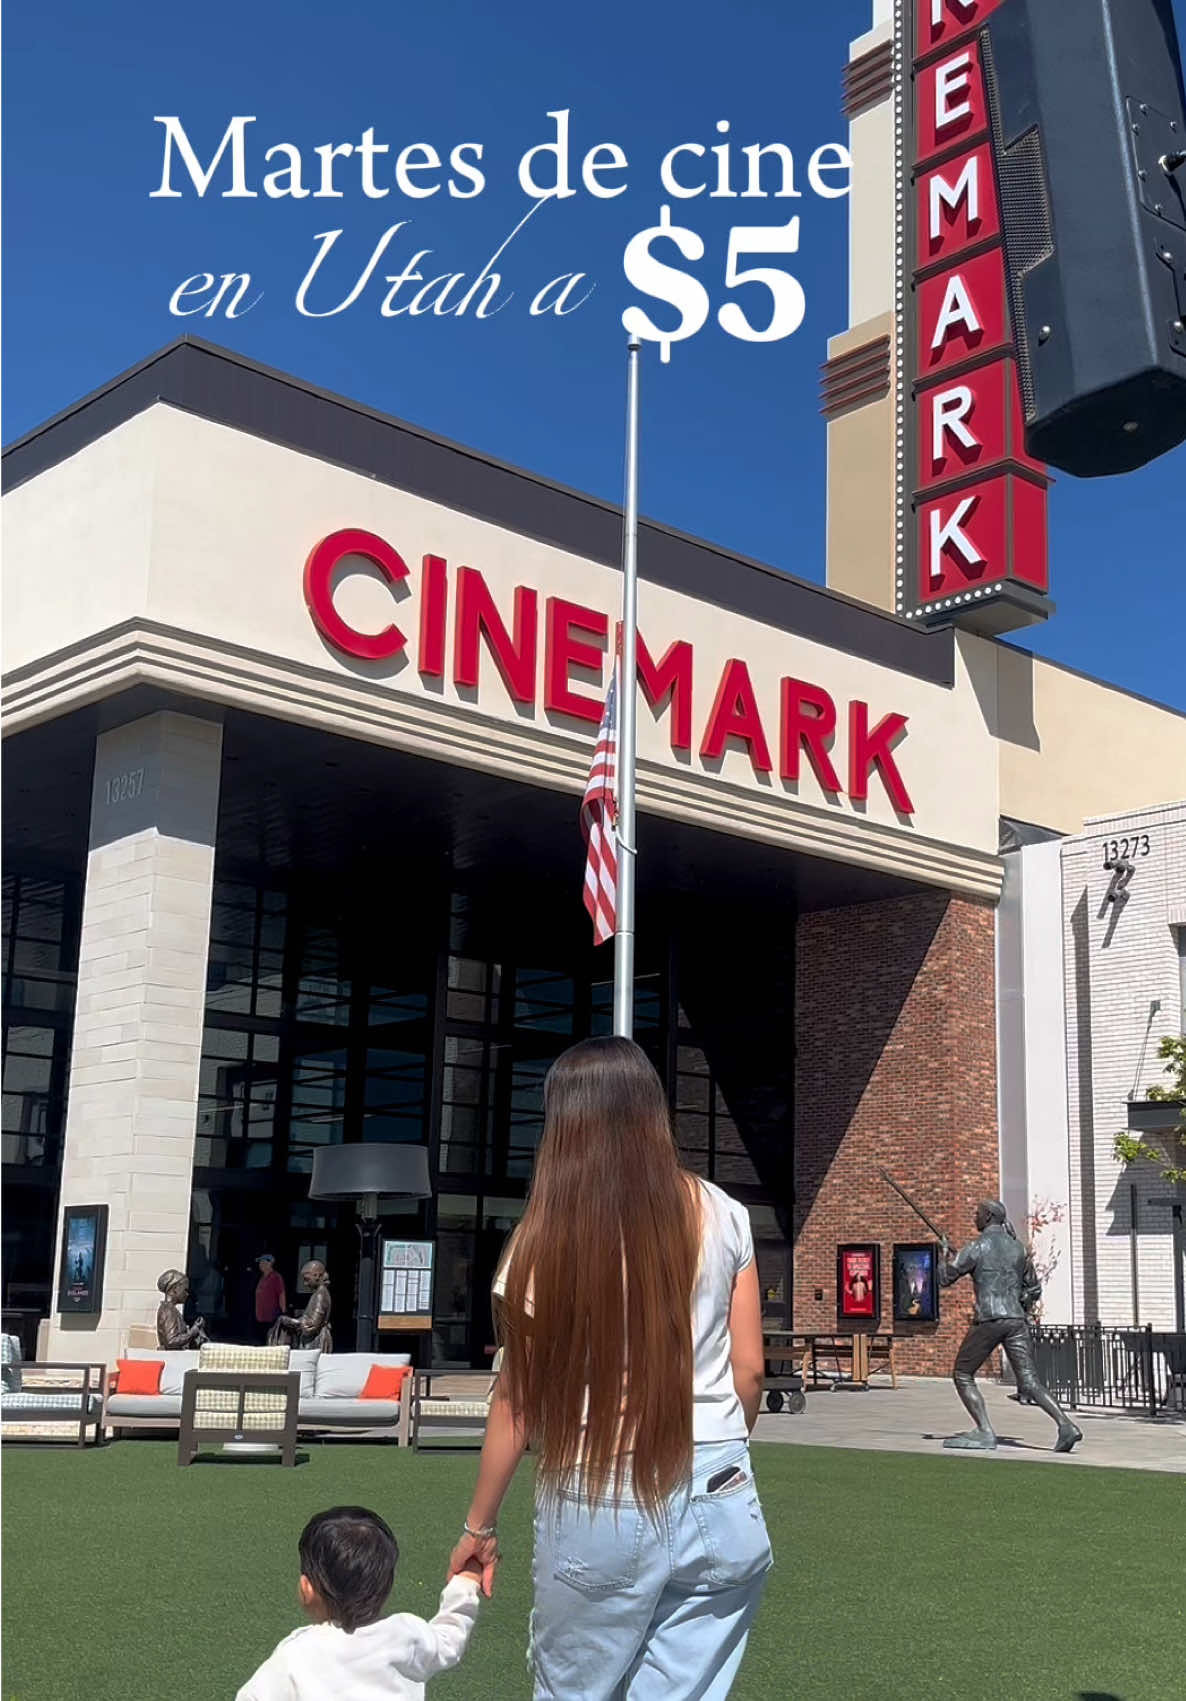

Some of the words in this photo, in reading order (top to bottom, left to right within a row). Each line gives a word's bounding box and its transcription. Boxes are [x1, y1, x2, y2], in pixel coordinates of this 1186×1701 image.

[931, 0, 983, 577] EMARK
[303, 528, 915, 816] CINEMARK
[1102, 834, 1151, 863] 13273
